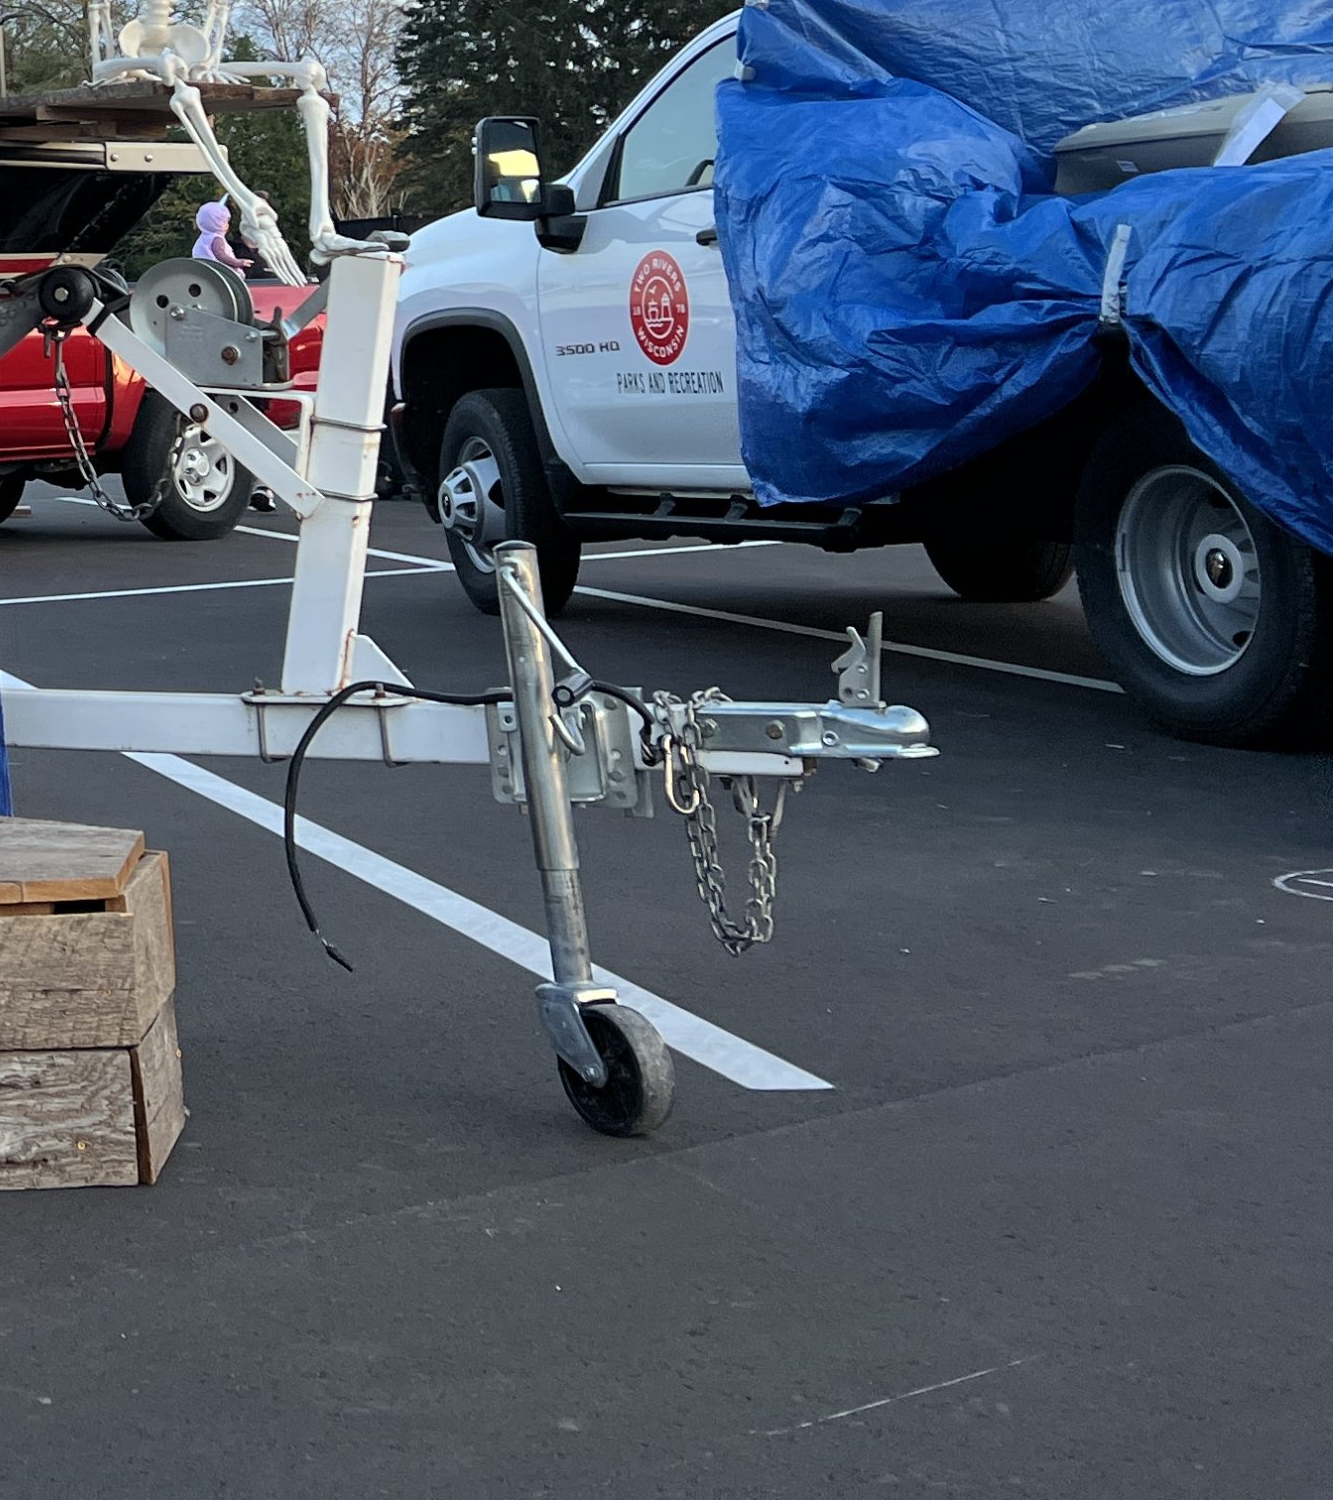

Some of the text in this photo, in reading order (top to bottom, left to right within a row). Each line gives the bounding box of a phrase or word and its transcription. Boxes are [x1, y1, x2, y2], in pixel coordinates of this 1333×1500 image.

[634, 258, 682, 293] TWO RIVERS
[556, 340, 620, 357] 3500 HD
[637, 325, 685, 359] WISCONSIN
[616, 370, 724, 394] PARKS AND RECREATION
